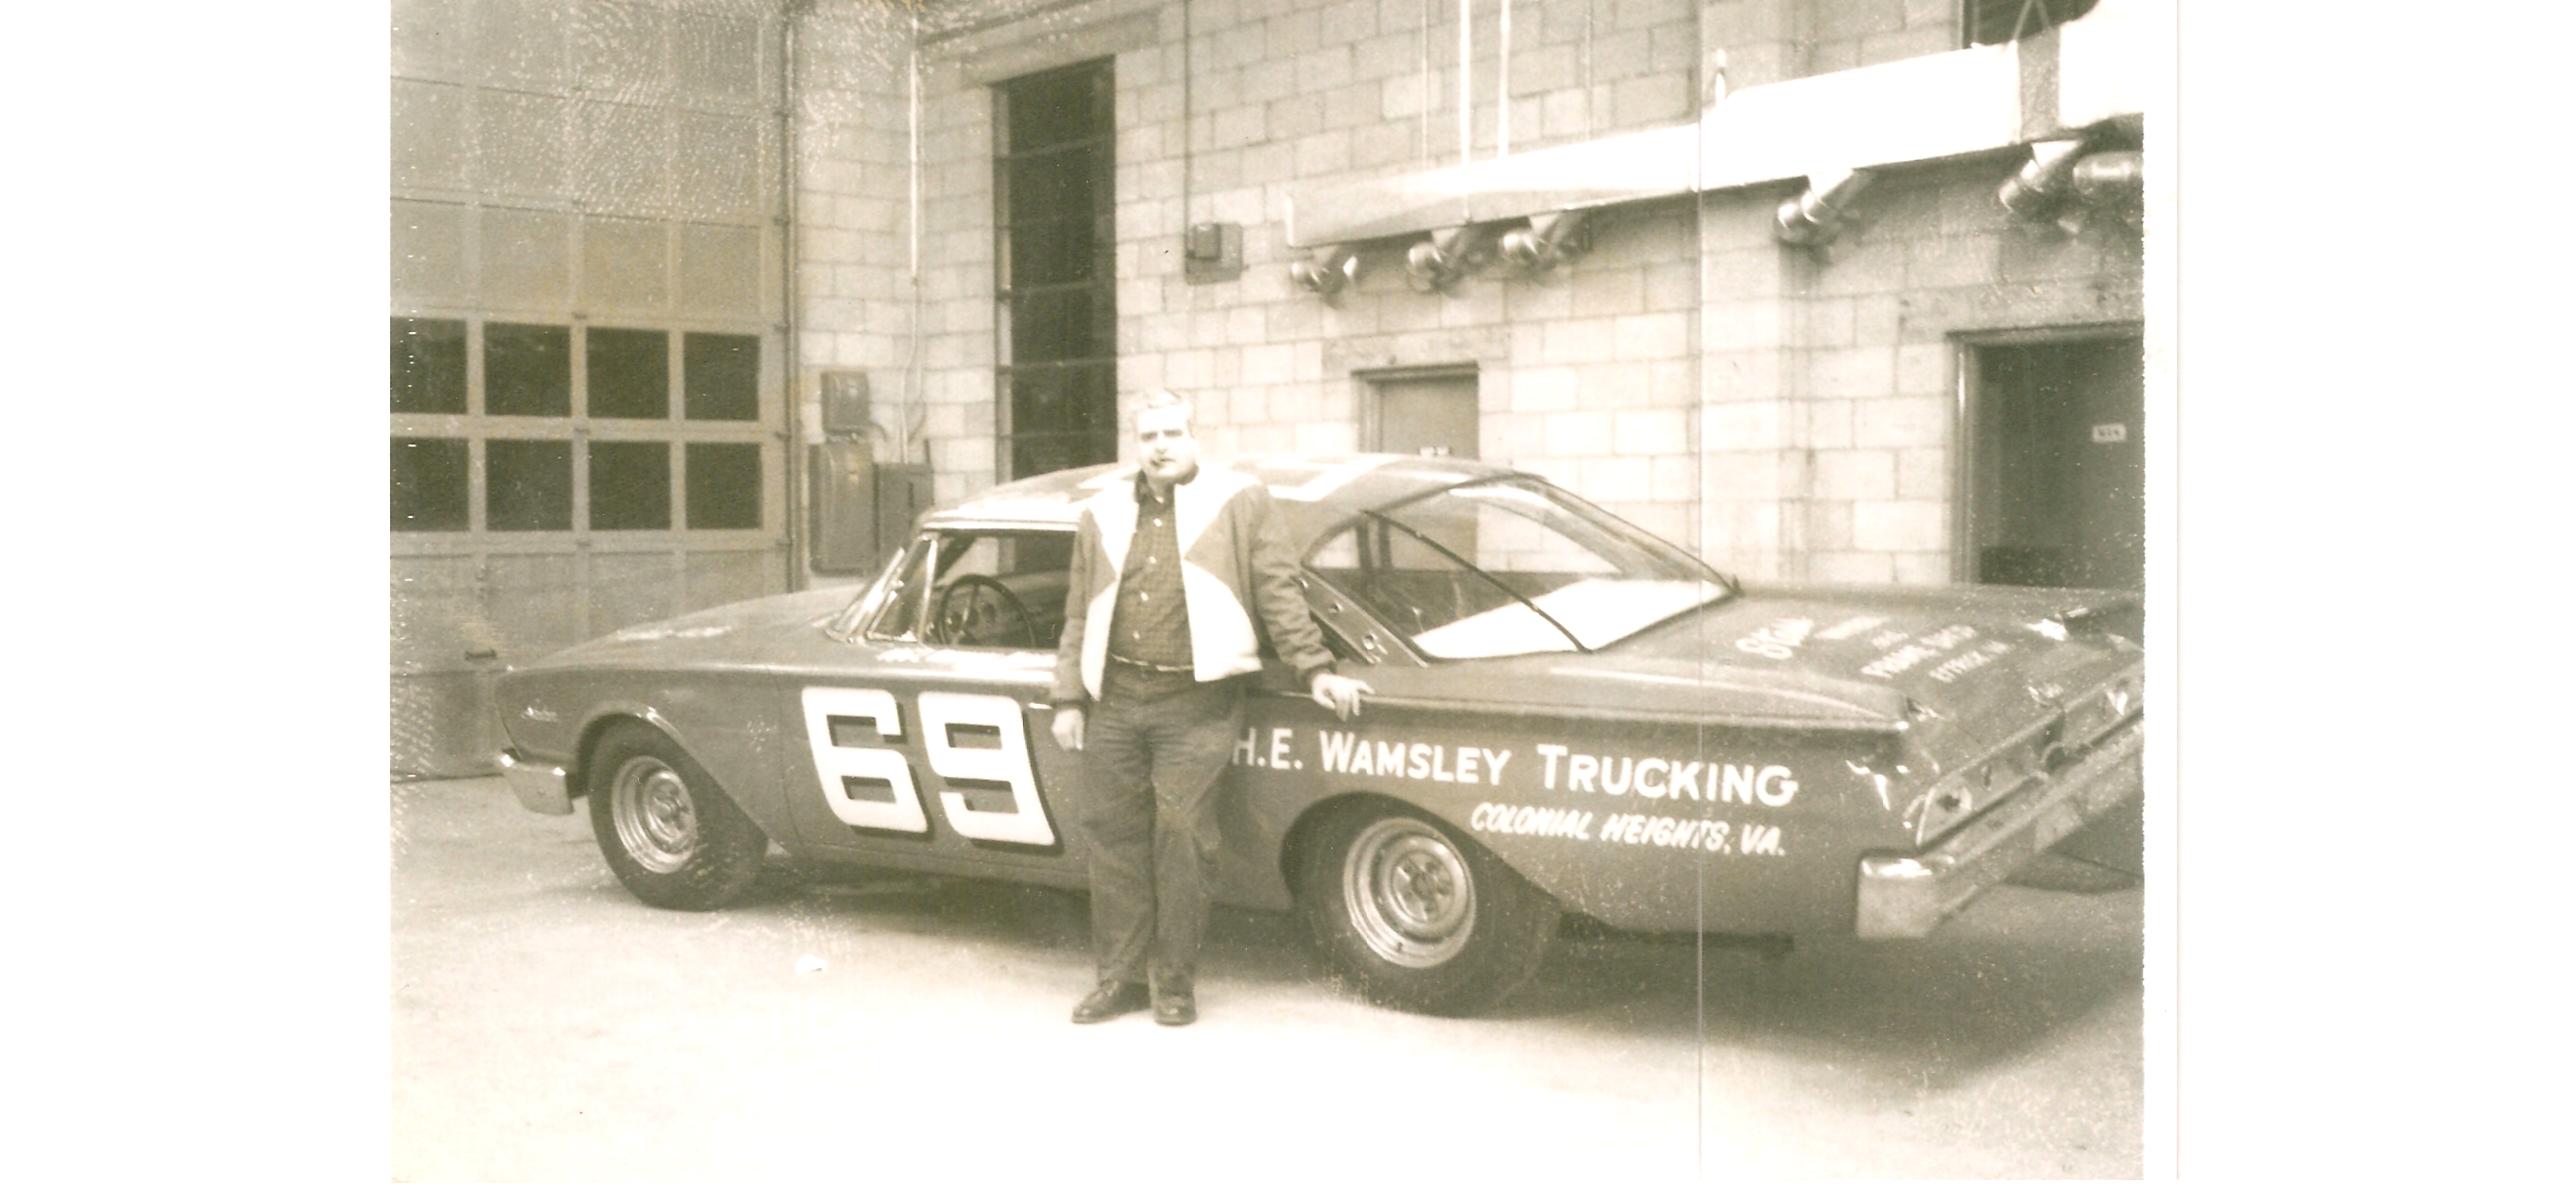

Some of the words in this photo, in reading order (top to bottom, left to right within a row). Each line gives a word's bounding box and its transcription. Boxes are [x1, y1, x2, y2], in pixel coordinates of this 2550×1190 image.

[801, 685, 1056, 847] 69
[1318, 729, 1512, 786] WAMSLEY
[1536, 743, 1799, 808] TRUCKING
[1471, 801, 1594, 841] COLONIAL
[1599, 813, 1732, 855] HEIGHTS,
[1739, 823, 1786, 857] VA.
